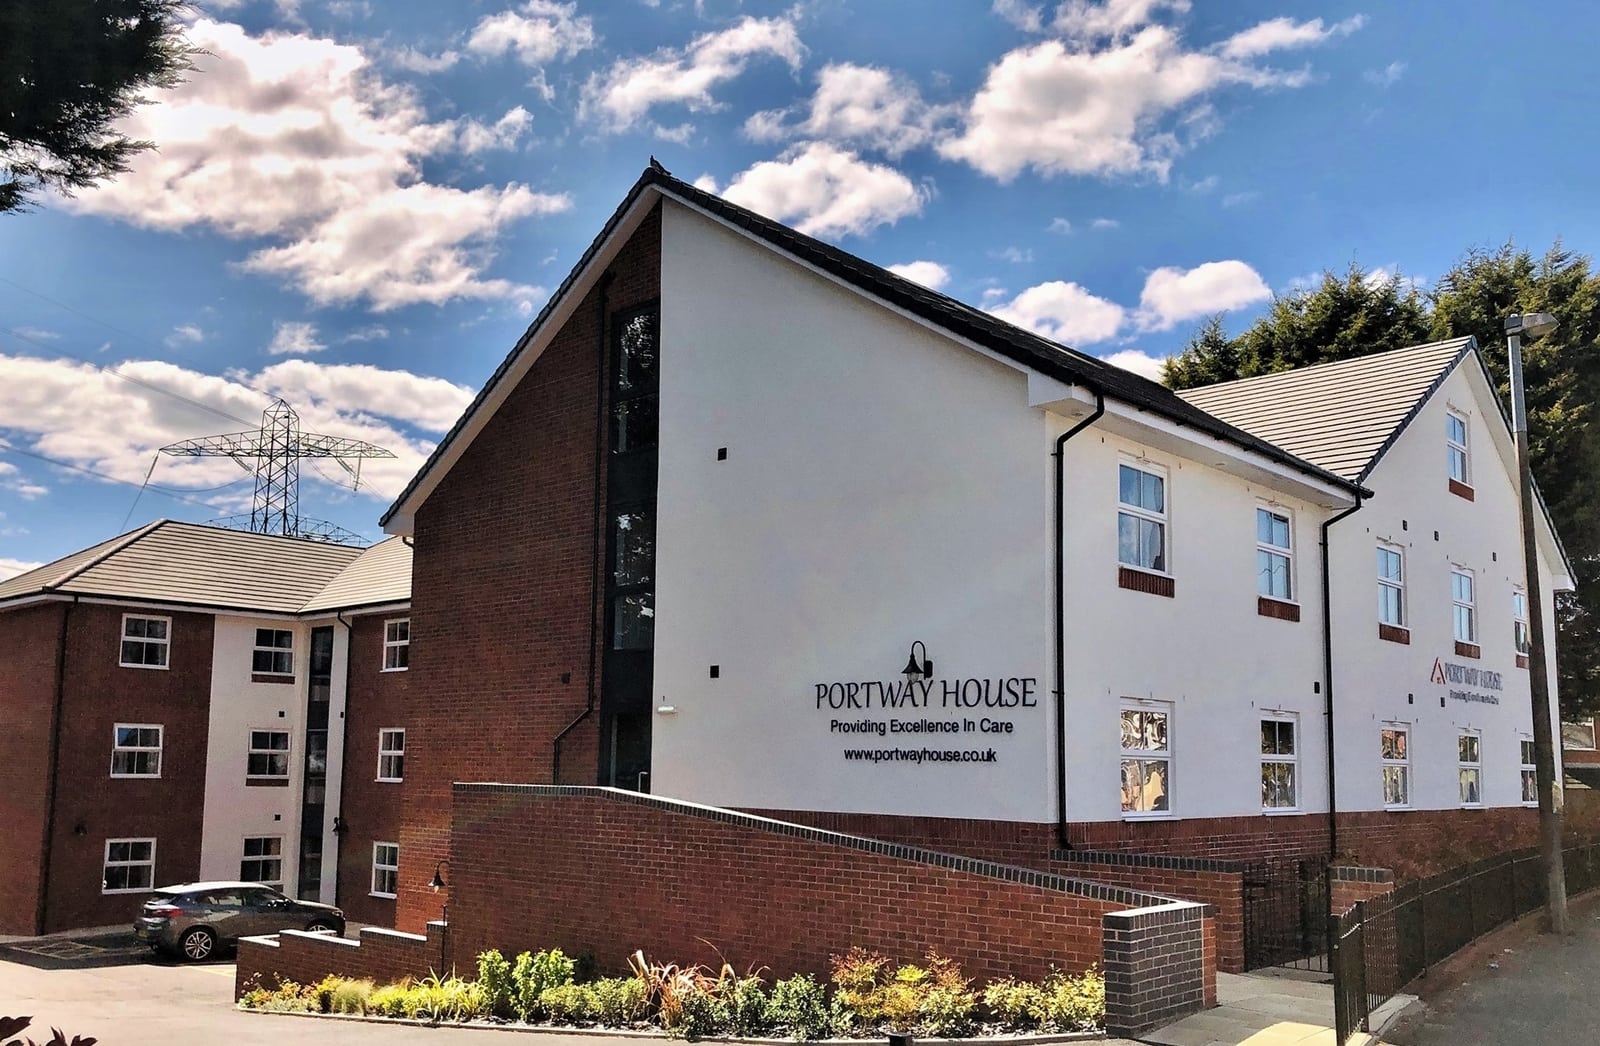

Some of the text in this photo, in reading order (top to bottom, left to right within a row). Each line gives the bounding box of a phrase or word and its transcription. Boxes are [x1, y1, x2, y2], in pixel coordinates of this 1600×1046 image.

[814, 677, 1038, 710] PORTWAY HOUSE
[830, 717, 1014, 736] Providing Excellence In Care
[843, 746, 998, 764] www.portwayhouse.co.uk
